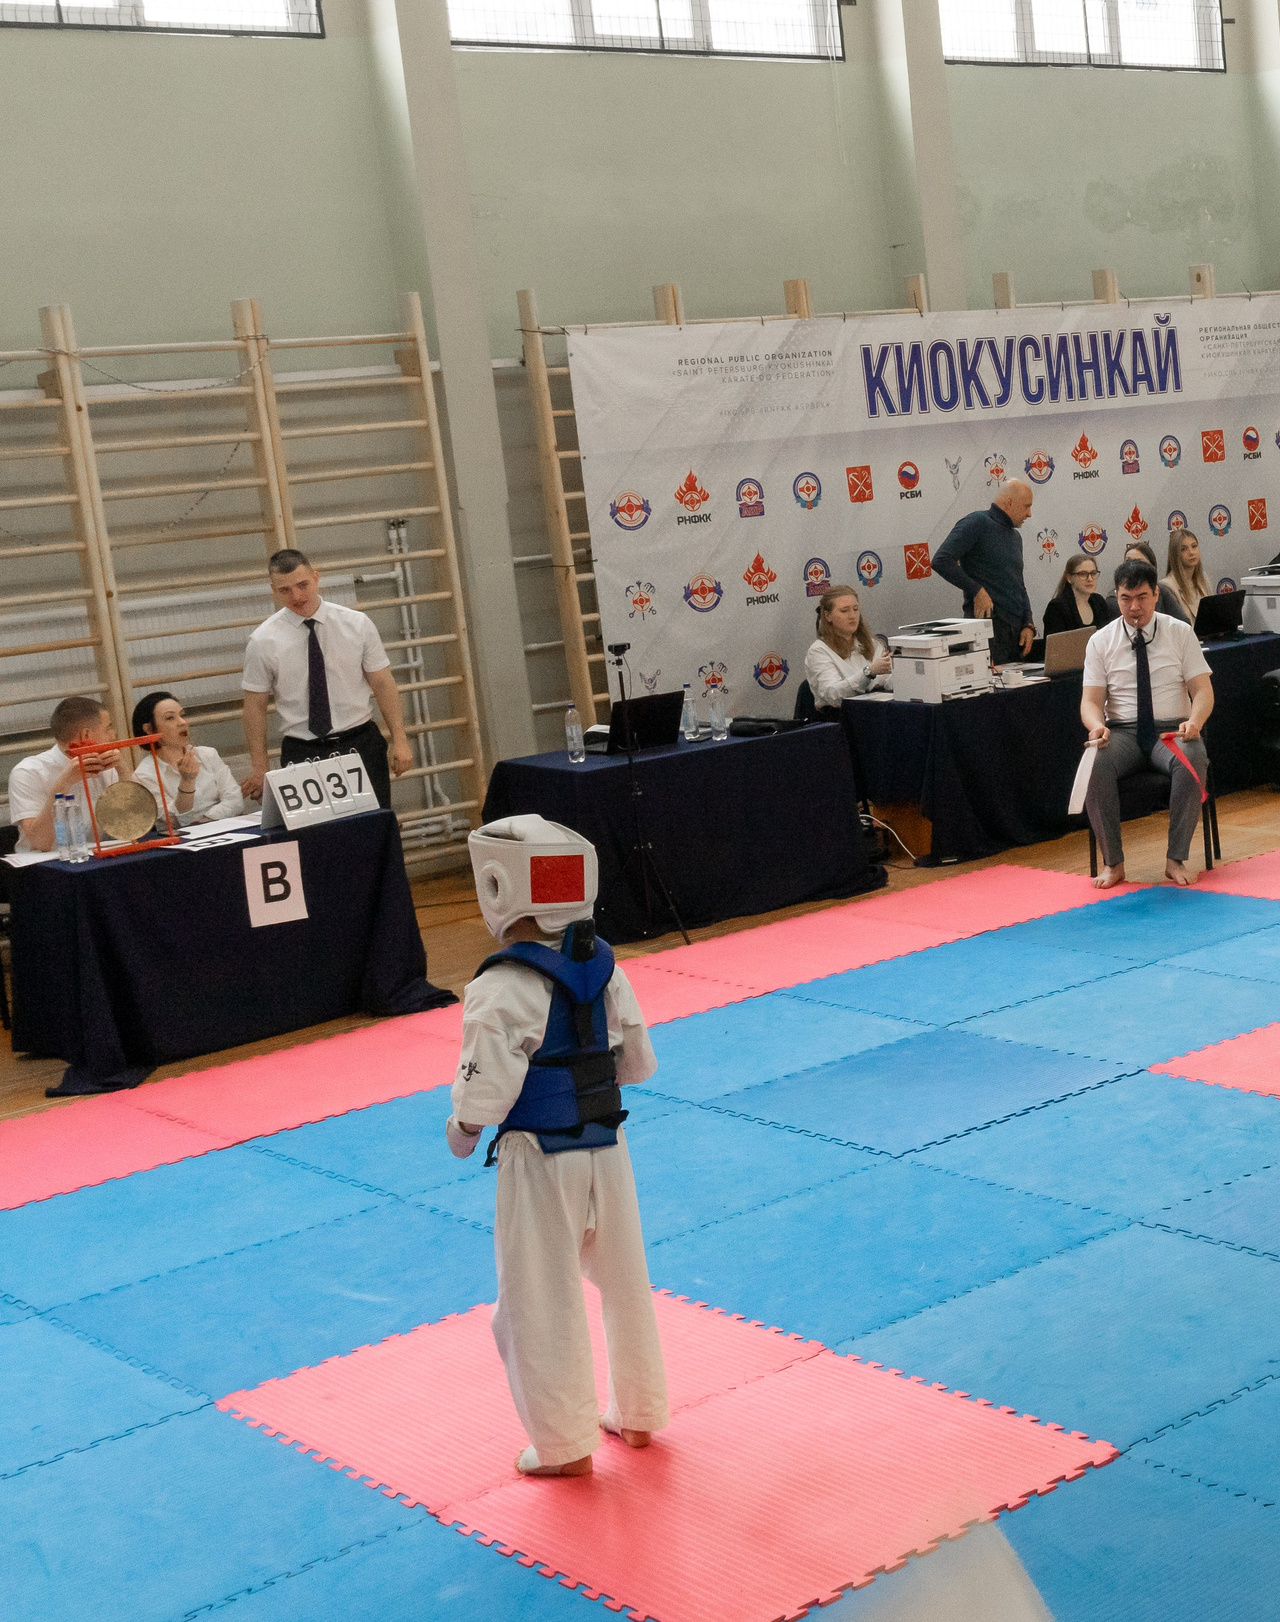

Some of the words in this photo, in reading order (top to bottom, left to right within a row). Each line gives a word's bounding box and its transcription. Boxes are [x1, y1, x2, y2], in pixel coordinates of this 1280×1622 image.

[1198, 325, 1251, 334] РЕГИОНАЛЬНАЯ
[1199, 333, 1248, 342] ОРГАНИЗАЦИЯ
[677, 356, 725, 367] REGIONAL
[728, 354, 760, 364] PUBLIC
[764, 350, 833, 361] ORGANIZATION
[707, 364, 764, 376] PETERSBURG
[768, 360, 834, 372] KYOKUSHINKAI
[859, 312, 1183, 418] КИОКУСИНКАЙ
[1243, 452, 1262, 460] РСБИ
[1073, 470, 1100, 480] РНФКК
[899, 490, 922, 500] РСБИ
[677, 513, 712, 525] РНФКК
[746, 593, 780, 606] РНФКК
[279, 766, 367, 812] B037
[260, 860, 292, 904] B
